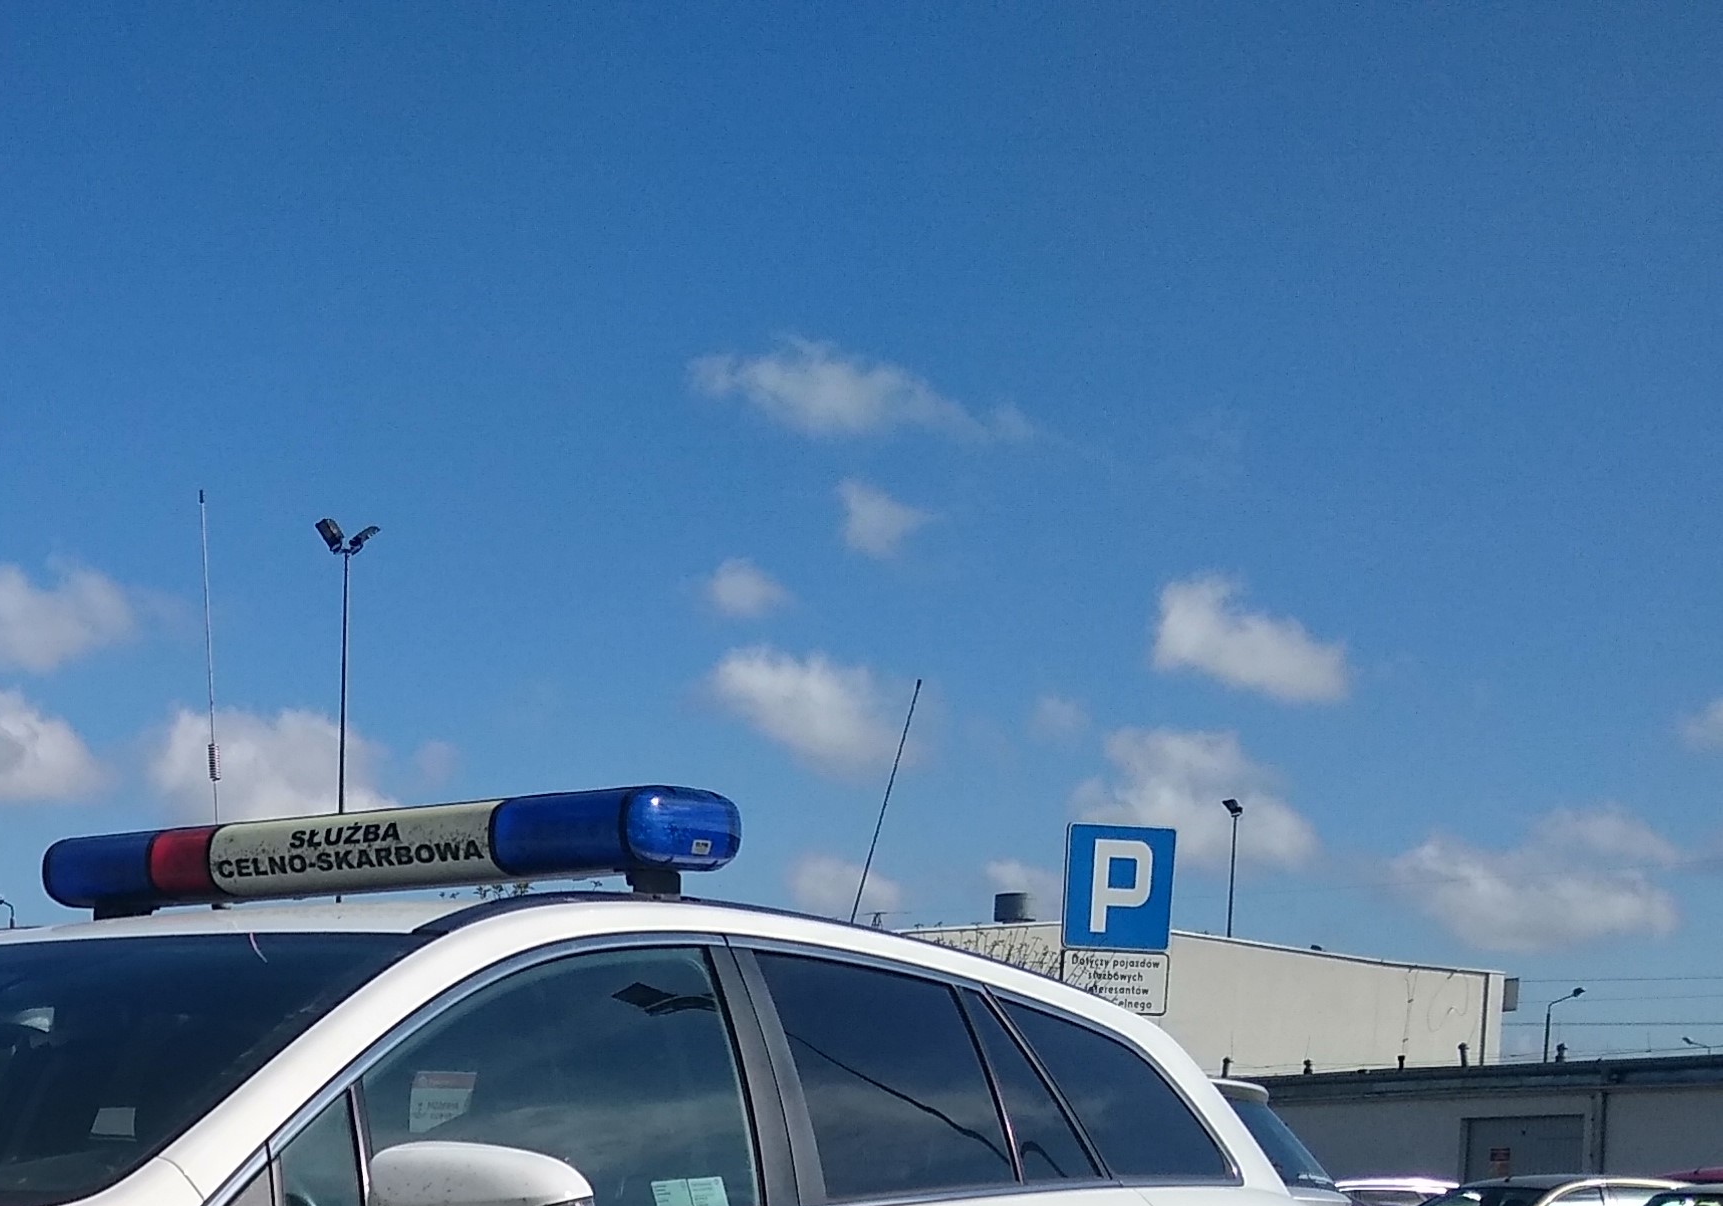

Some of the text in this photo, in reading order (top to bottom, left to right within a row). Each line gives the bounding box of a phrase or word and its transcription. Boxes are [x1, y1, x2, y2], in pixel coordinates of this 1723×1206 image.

[289, 821, 401, 850] SŁUŻBA
[216, 840, 484, 879] CELNO-SKARBOWA
[1089, 838, 1153, 933] P
